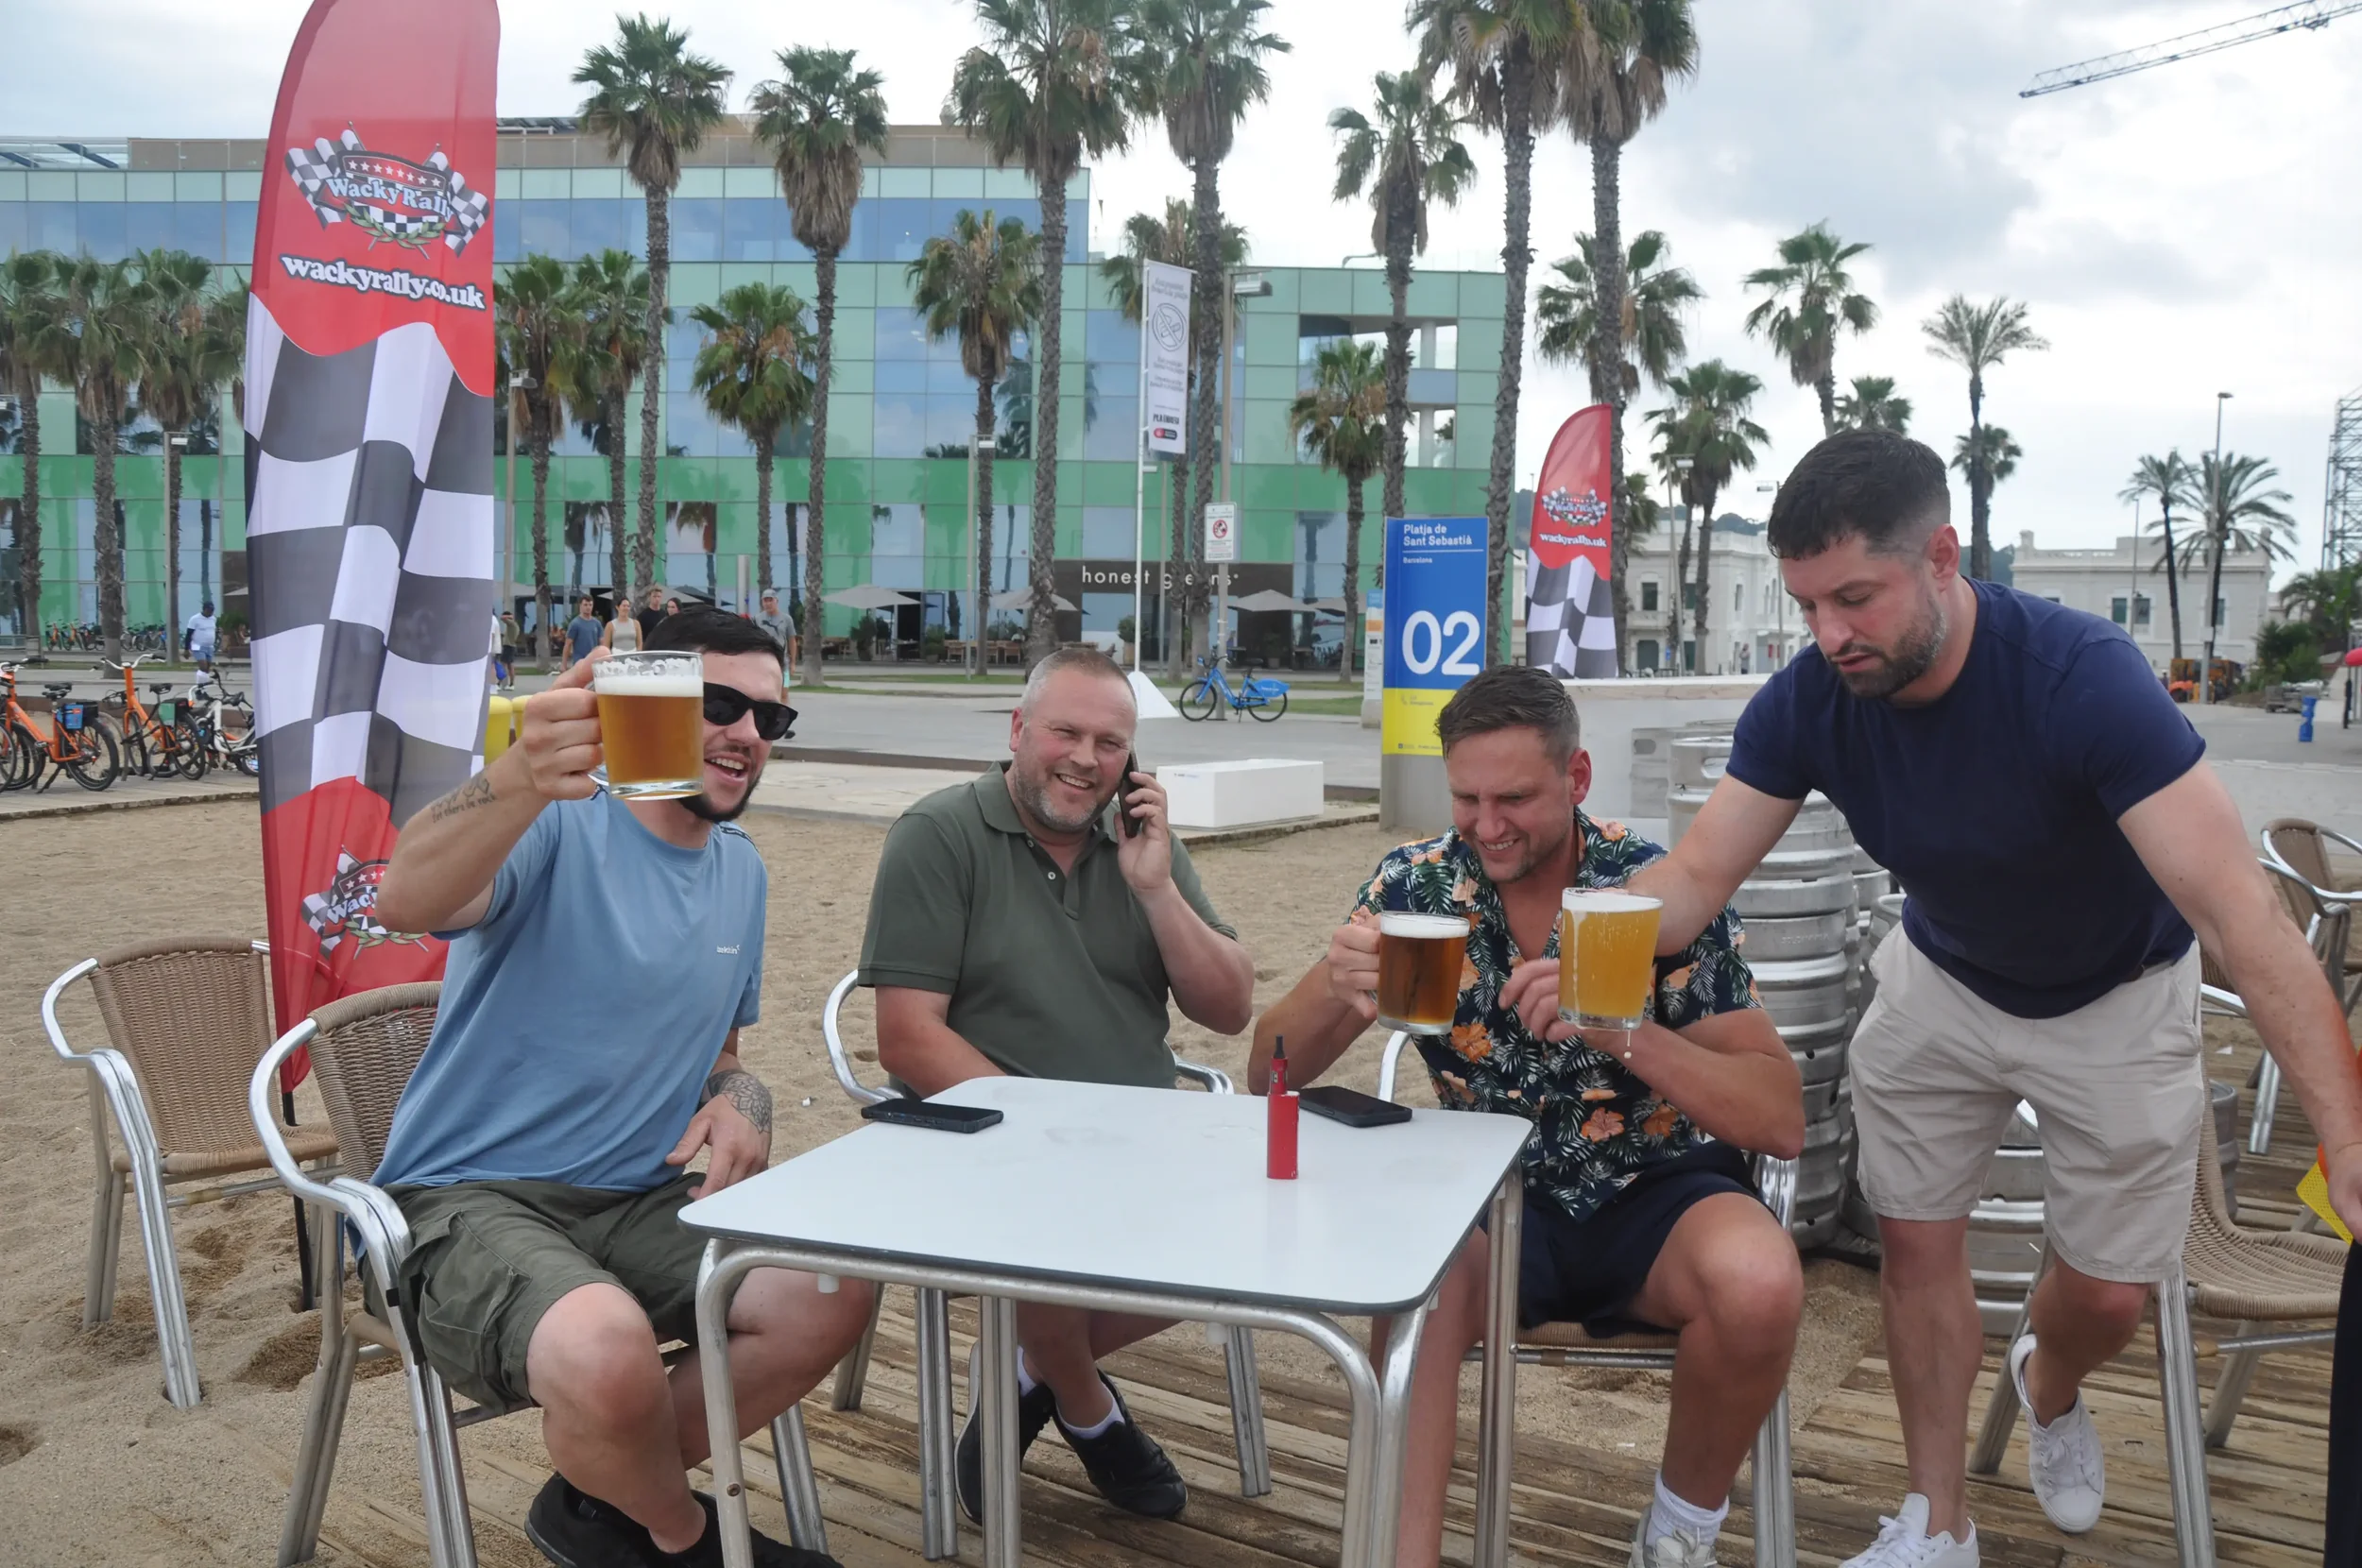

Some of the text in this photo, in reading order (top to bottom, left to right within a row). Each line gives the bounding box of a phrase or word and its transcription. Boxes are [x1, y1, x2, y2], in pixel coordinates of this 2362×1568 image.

[325, 177, 454, 223] Wacky Rally
[281, 255, 486, 310] wackyrally.co.uk
[1403, 523, 1447, 536] Platja de
[1403, 535, 1472, 546] Sant Sebastià
[1402, 610, 1481, 675] 02
[327, 893, 377, 924] Wac
